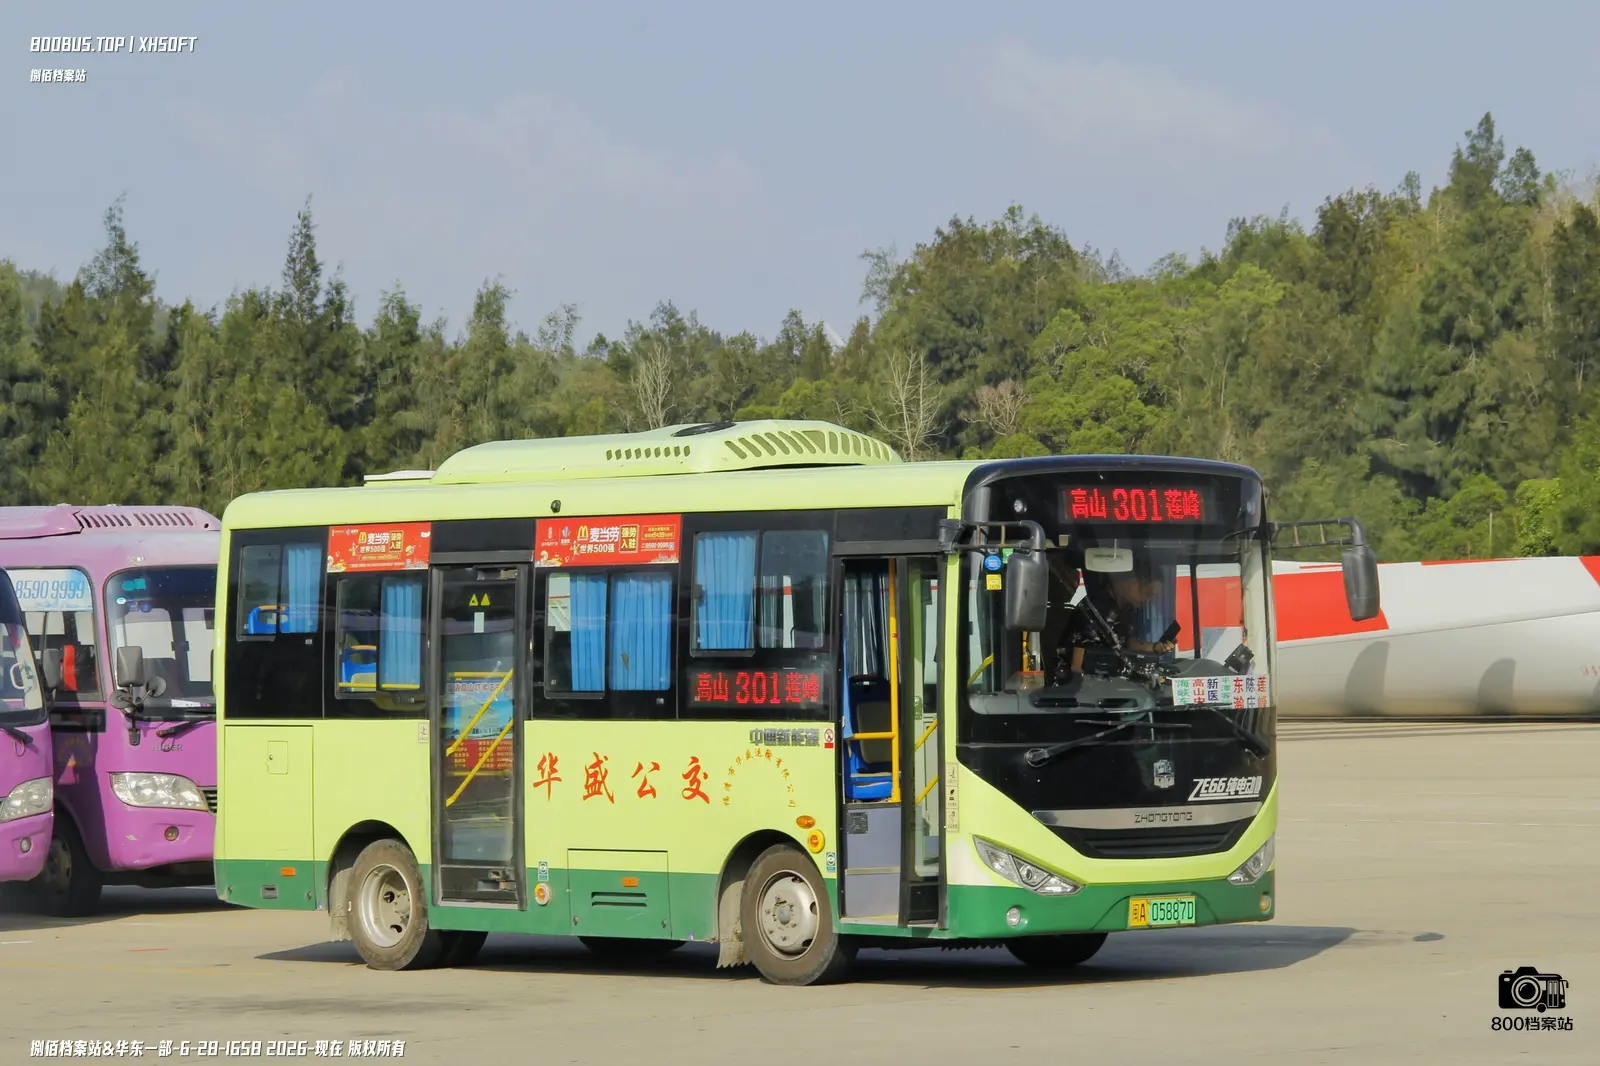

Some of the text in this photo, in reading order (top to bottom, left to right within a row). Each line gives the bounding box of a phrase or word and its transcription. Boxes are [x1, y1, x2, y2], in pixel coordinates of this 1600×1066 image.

[1070, 488, 1201, 521] 高山 301 莲峰
[367, 532, 390, 545] 麦当劳
[589, 526, 620, 543] 麦当劳
[621, 526, 637, 538] 强势
[579, 543, 615, 554] 世界500强
[620, 538, 637, 549] 入驻
[15, 580, 85, 600] 8590 9999
[696, 671, 820, 704] 高山 301 莲峰
[533, 751, 710, 804] 华盛公交
[1134, 811, 1193, 823] ZHONGTONG
